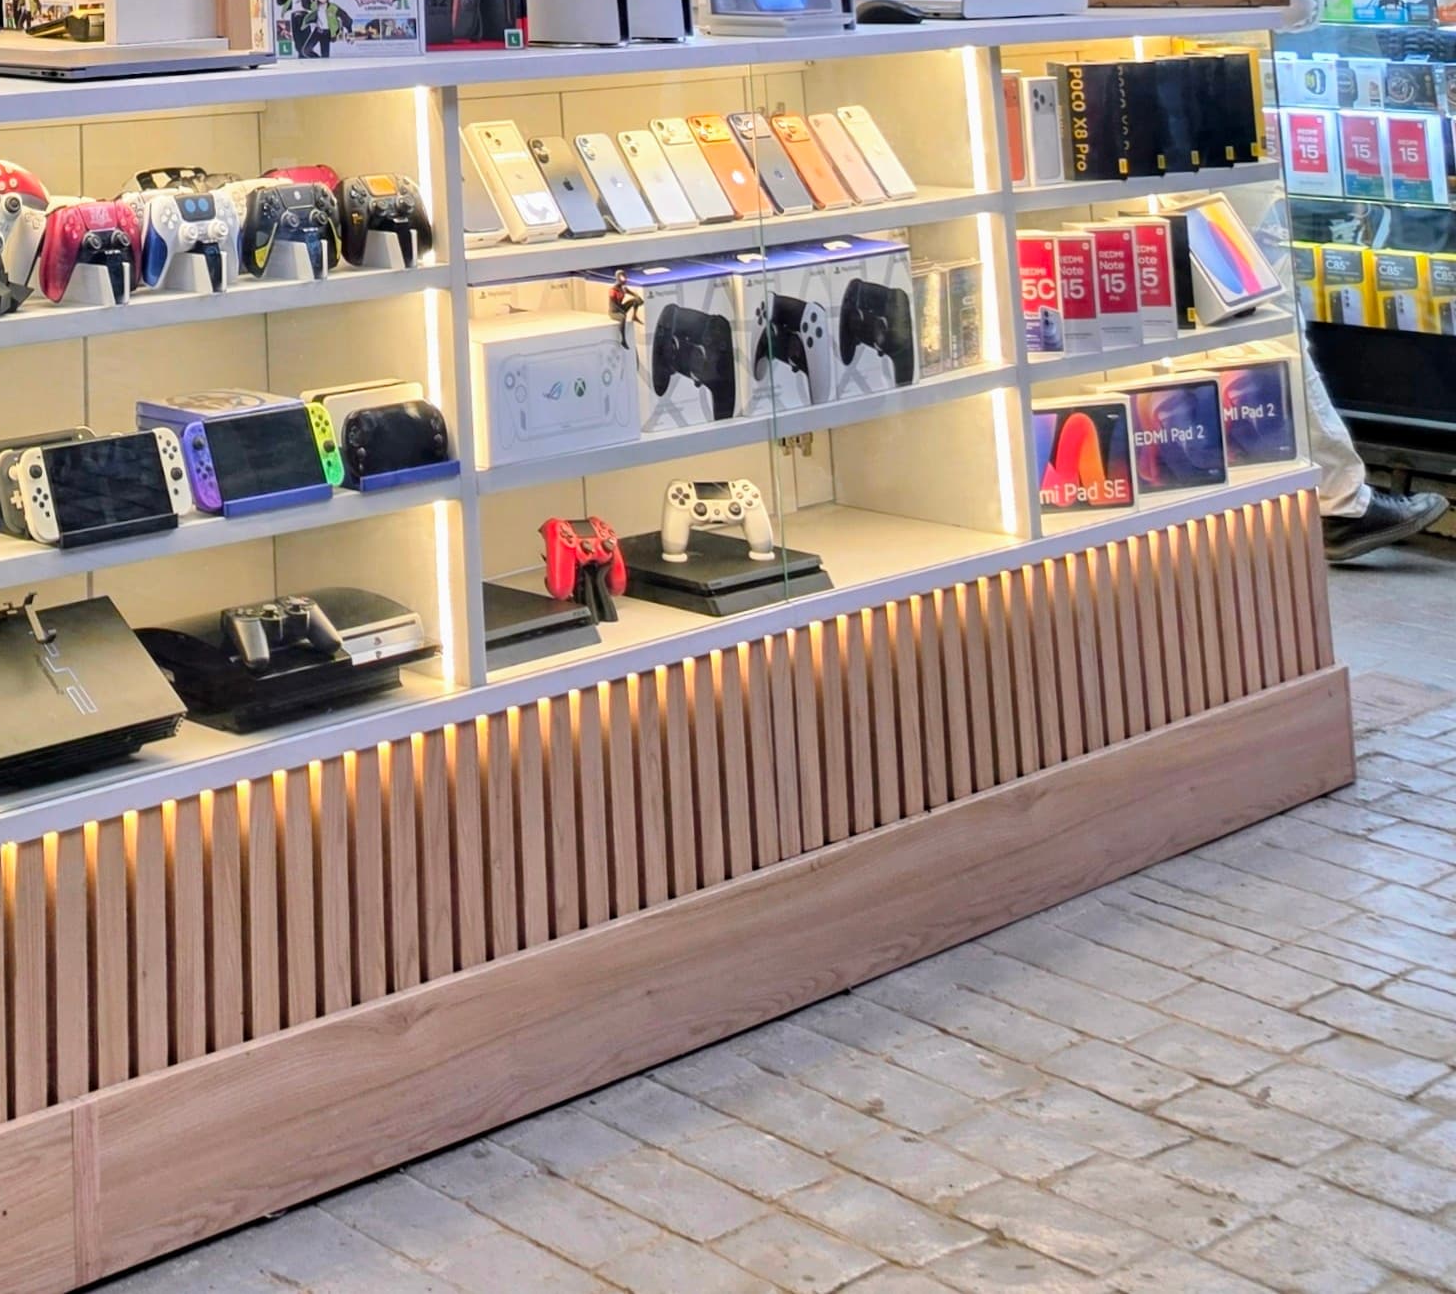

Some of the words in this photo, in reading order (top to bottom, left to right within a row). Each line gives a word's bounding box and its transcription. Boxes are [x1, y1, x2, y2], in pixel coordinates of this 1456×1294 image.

[1069, 67, 1086, 113] POCO
[1073, 116, 1089, 140] X8
[1075, 143, 1090, 172] Pro
[1298, 144, 1320, 159] 15
[1352, 143, 1371, 159] 15
[1399, 147, 1419, 162] 15
[1099, 250, 1124, 259] REDMI
[1060, 266, 1085, 276] Note
[1099, 261, 1125, 270] Note
[1101, 273, 1126, 294] 15
[1142, 267, 1158, 287] 5
[1021, 278, 1056, 300] 5C
[1062, 278, 1086, 300] 15
[1241, 405, 1264, 419] Pad
[1266, 402, 1275, 417] 2
[1171, 429, 1194, 443] Pad
[1196, 425, 1206, 440] 2
[1064, 482, 1099, 502] Pad
[1104, 478, 1127, 498] SE
